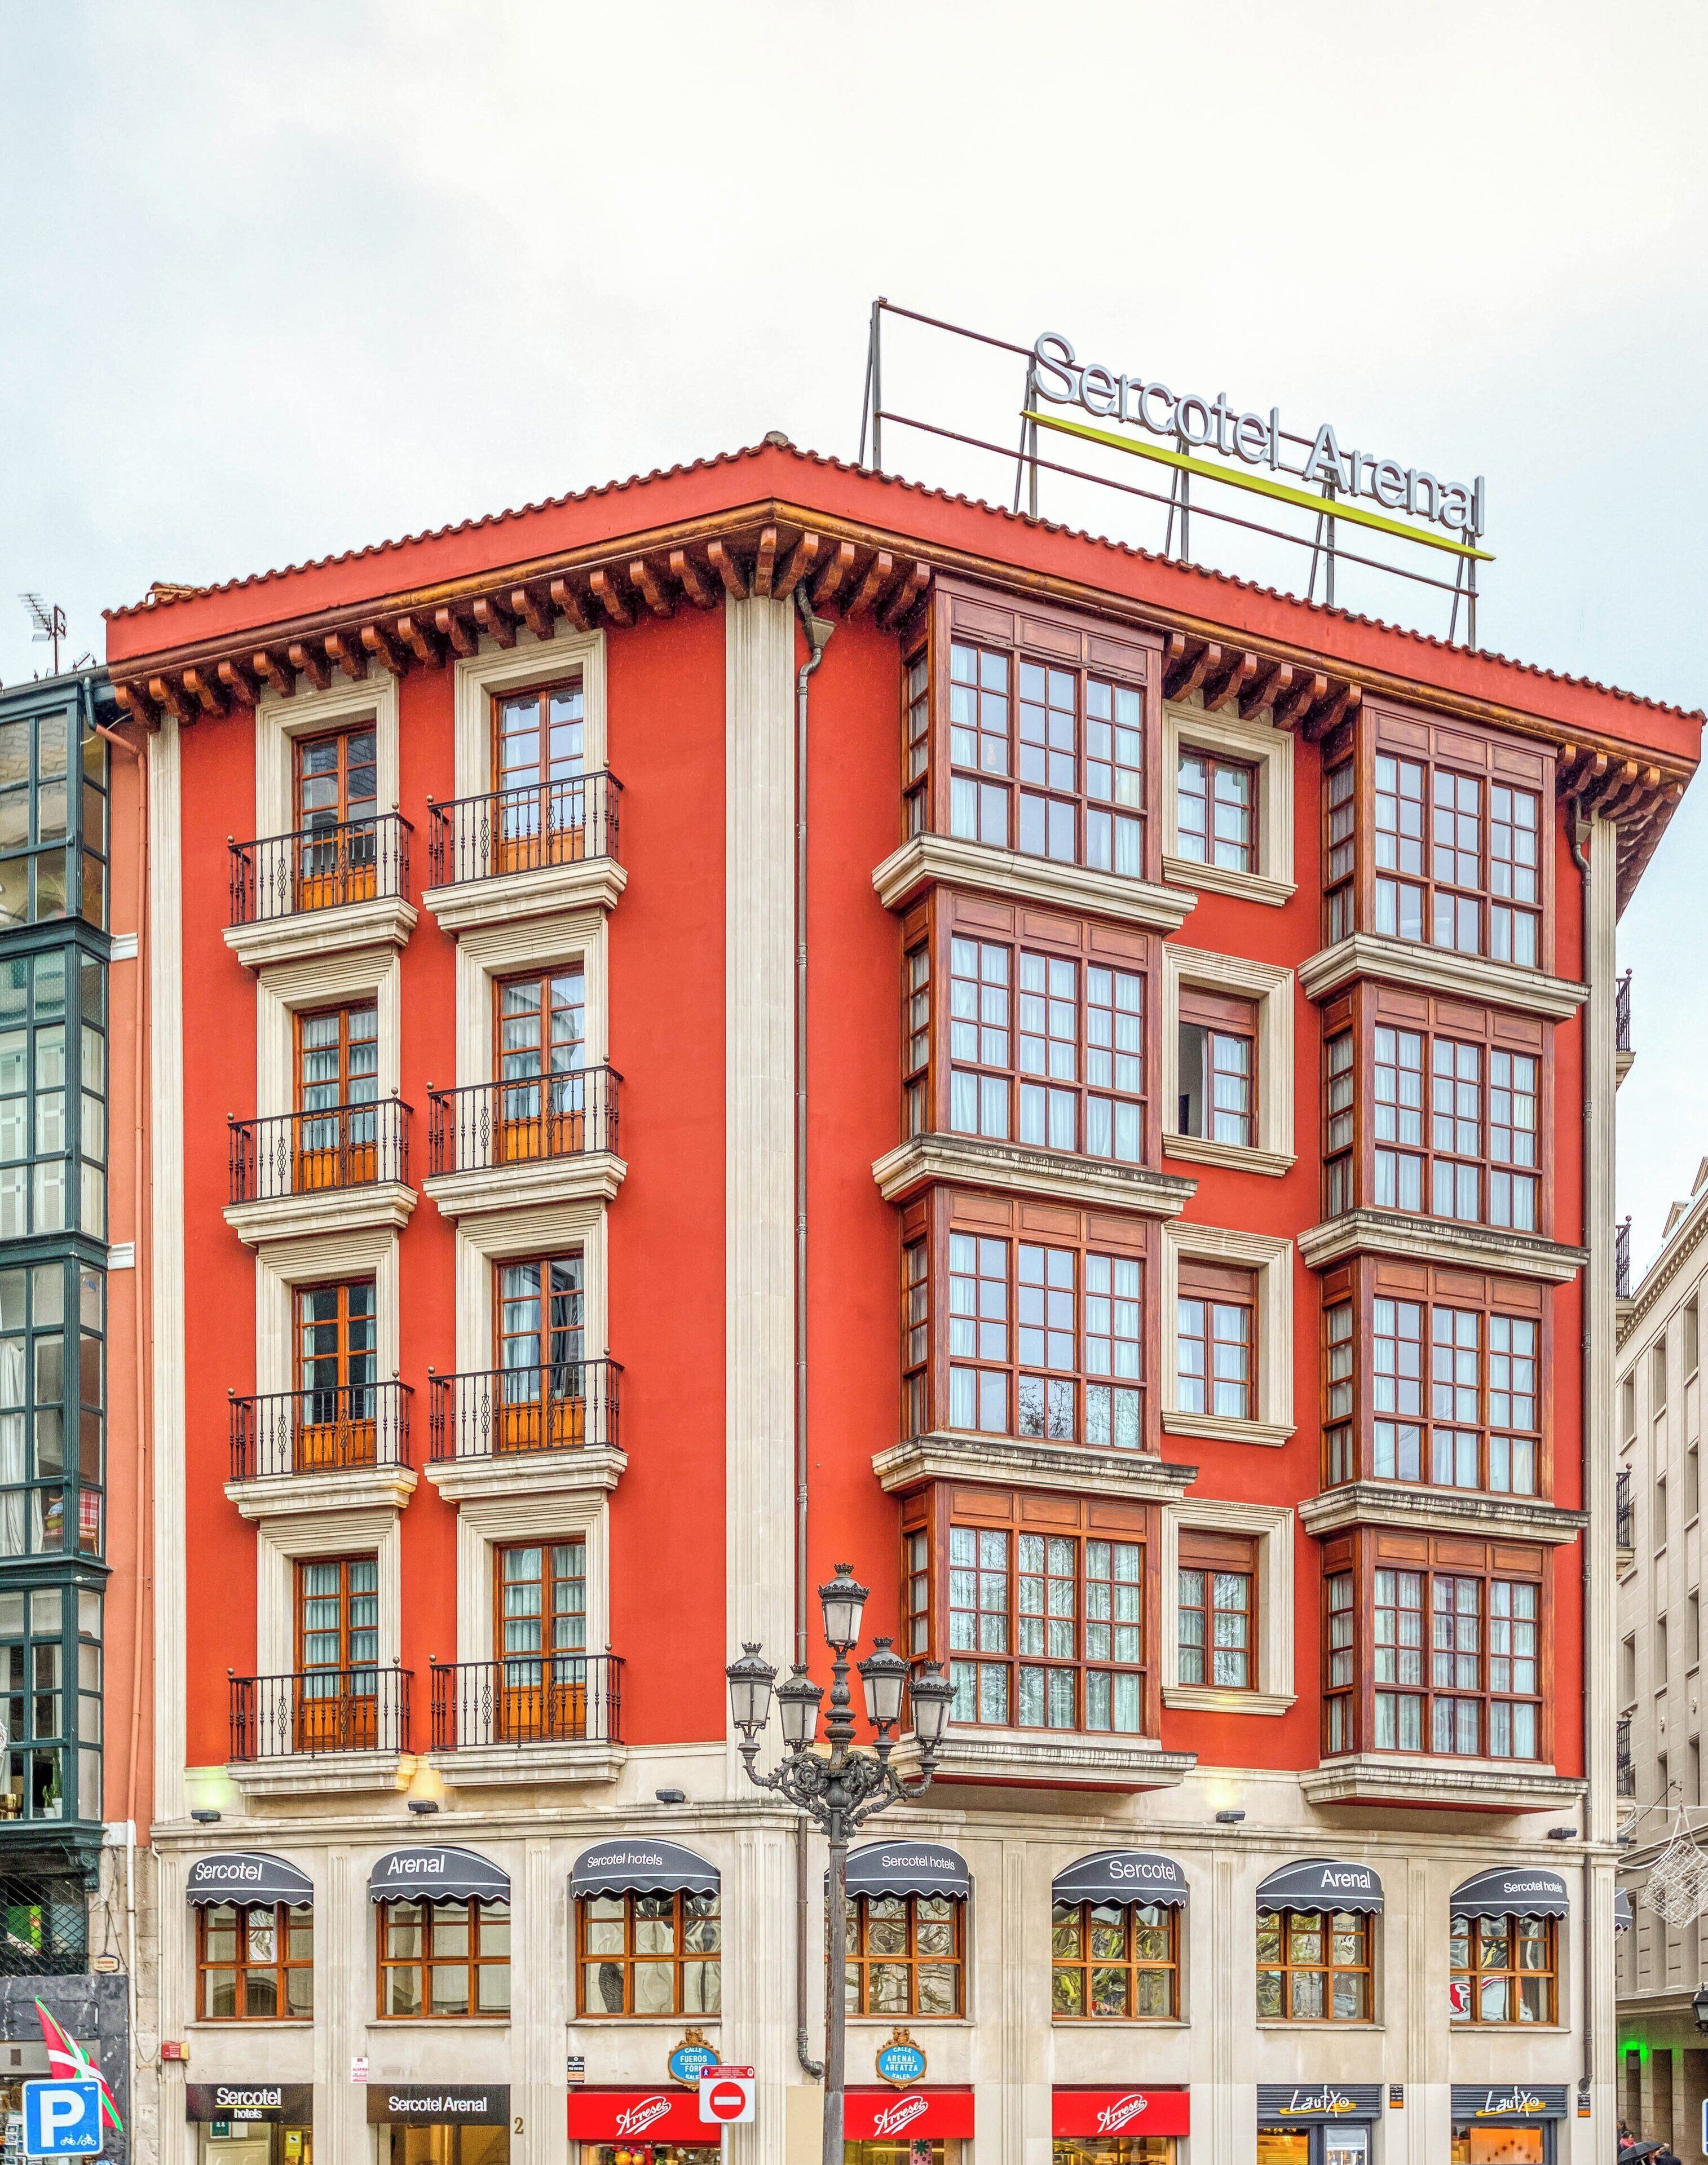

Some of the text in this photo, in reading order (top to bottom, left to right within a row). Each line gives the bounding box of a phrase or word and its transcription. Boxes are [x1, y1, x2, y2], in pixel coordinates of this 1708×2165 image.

[1031, 332, 1485, 537] Sercotel Arenal
[387, 1854, 445, 1876] Arenal
[587, 1853, 663, 1868] Sercotel hotels
[882, 1855, 955, 1871] Sercotel hotels
[195, 1862, 263, 1881] Sercotel
[1109, 1861, 1177, 1881] Sercotel
[1321, 1869, 1371, 1889] Arenal
[1504, 1881, 1563, 1893] Sercotel hotels
[216, 2087, 281, 2105] Sercotel
[388, 2096, 487, 2112] Sercotel Arenal
[39, 2089, 85, 2148] P
[233, 2107, 263, 2119] hotels
[514, 2117, 524, 2134] 2
